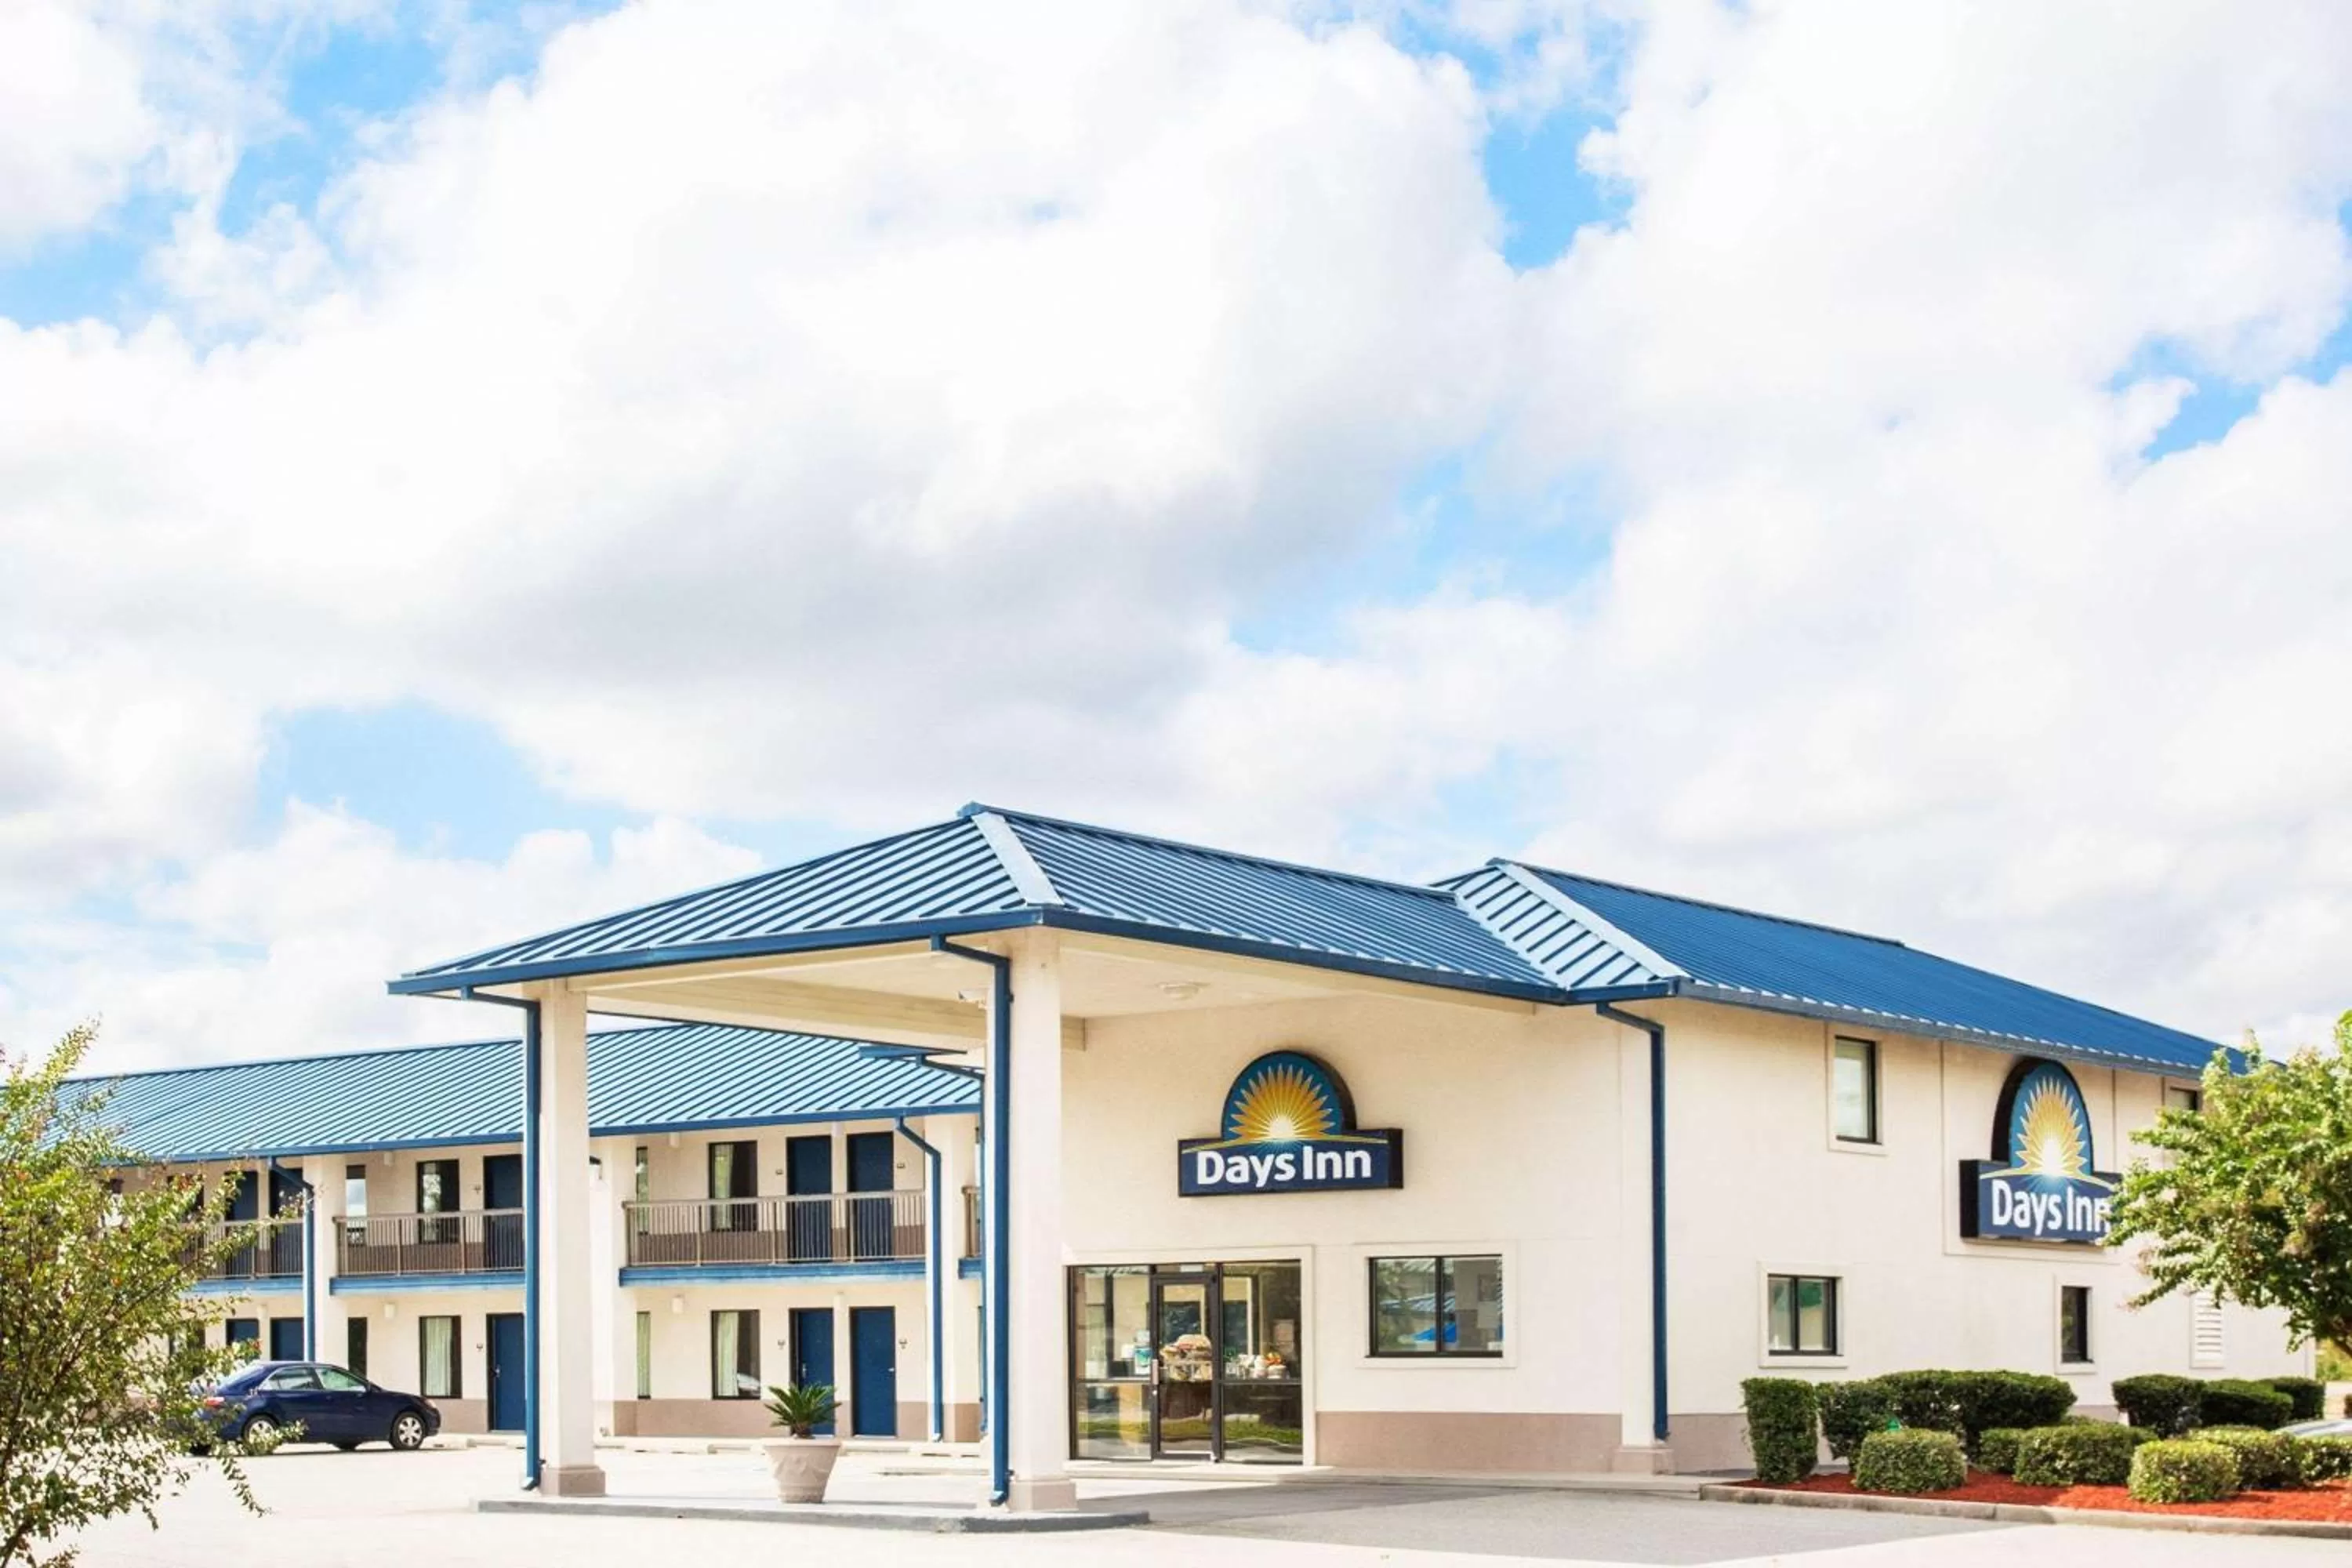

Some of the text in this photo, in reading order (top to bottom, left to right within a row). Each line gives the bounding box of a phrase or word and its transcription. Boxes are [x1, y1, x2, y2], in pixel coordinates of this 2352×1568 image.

[1196, 1145, 1372, 1188] Days Inn
[1991, 1178, 2112, 1236] Days Inn
